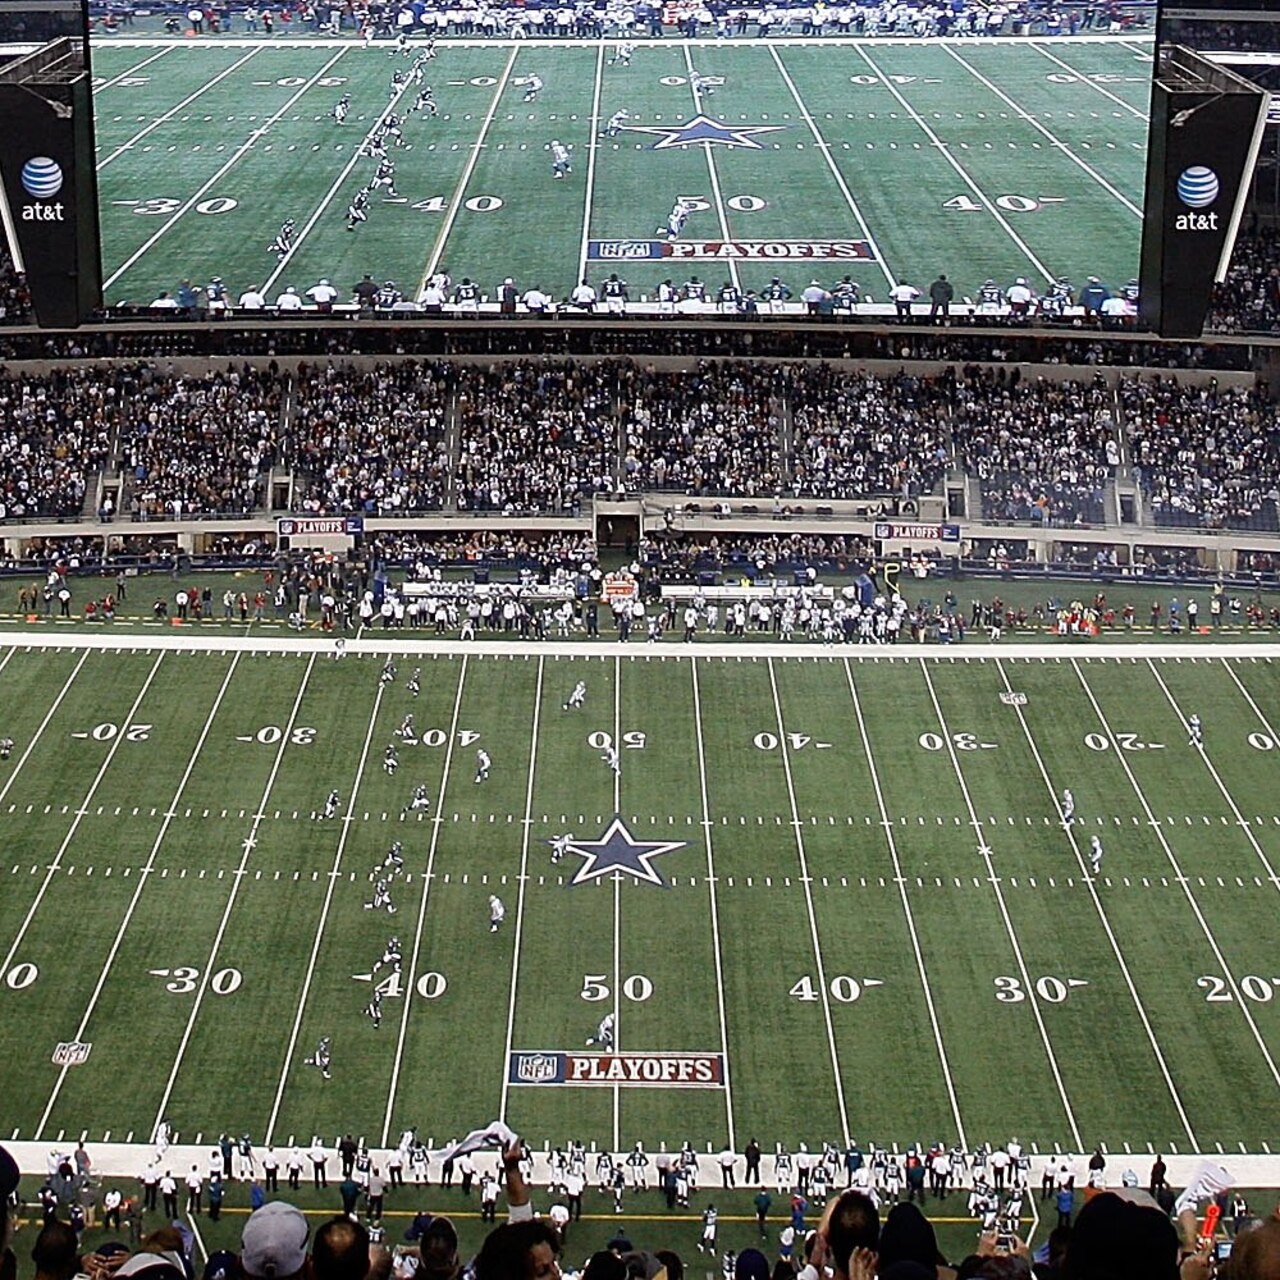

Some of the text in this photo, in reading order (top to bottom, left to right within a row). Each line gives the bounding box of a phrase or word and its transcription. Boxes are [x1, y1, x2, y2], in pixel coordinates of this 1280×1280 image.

[22, 202, 64, 221] at&t
[1176, 211, 1219, 231] at&t
[671, 242, 858, 258] PLAYOFFS
[297, 521, 342, 533] PLAYOFFS
[893, 526, 938, 538] PLAYOFFS
[165, 967, 242, 995] 30
[376, 972, 447, 999] 40
[580, 974, 653, 1001] 50
[789, 975, 862, 1002] 40
[994, 975, 1068, 1002] 30
[1196, 975, 1274, 1002] 20
[572, 1057, 713, 1081] PLAYOFFS
